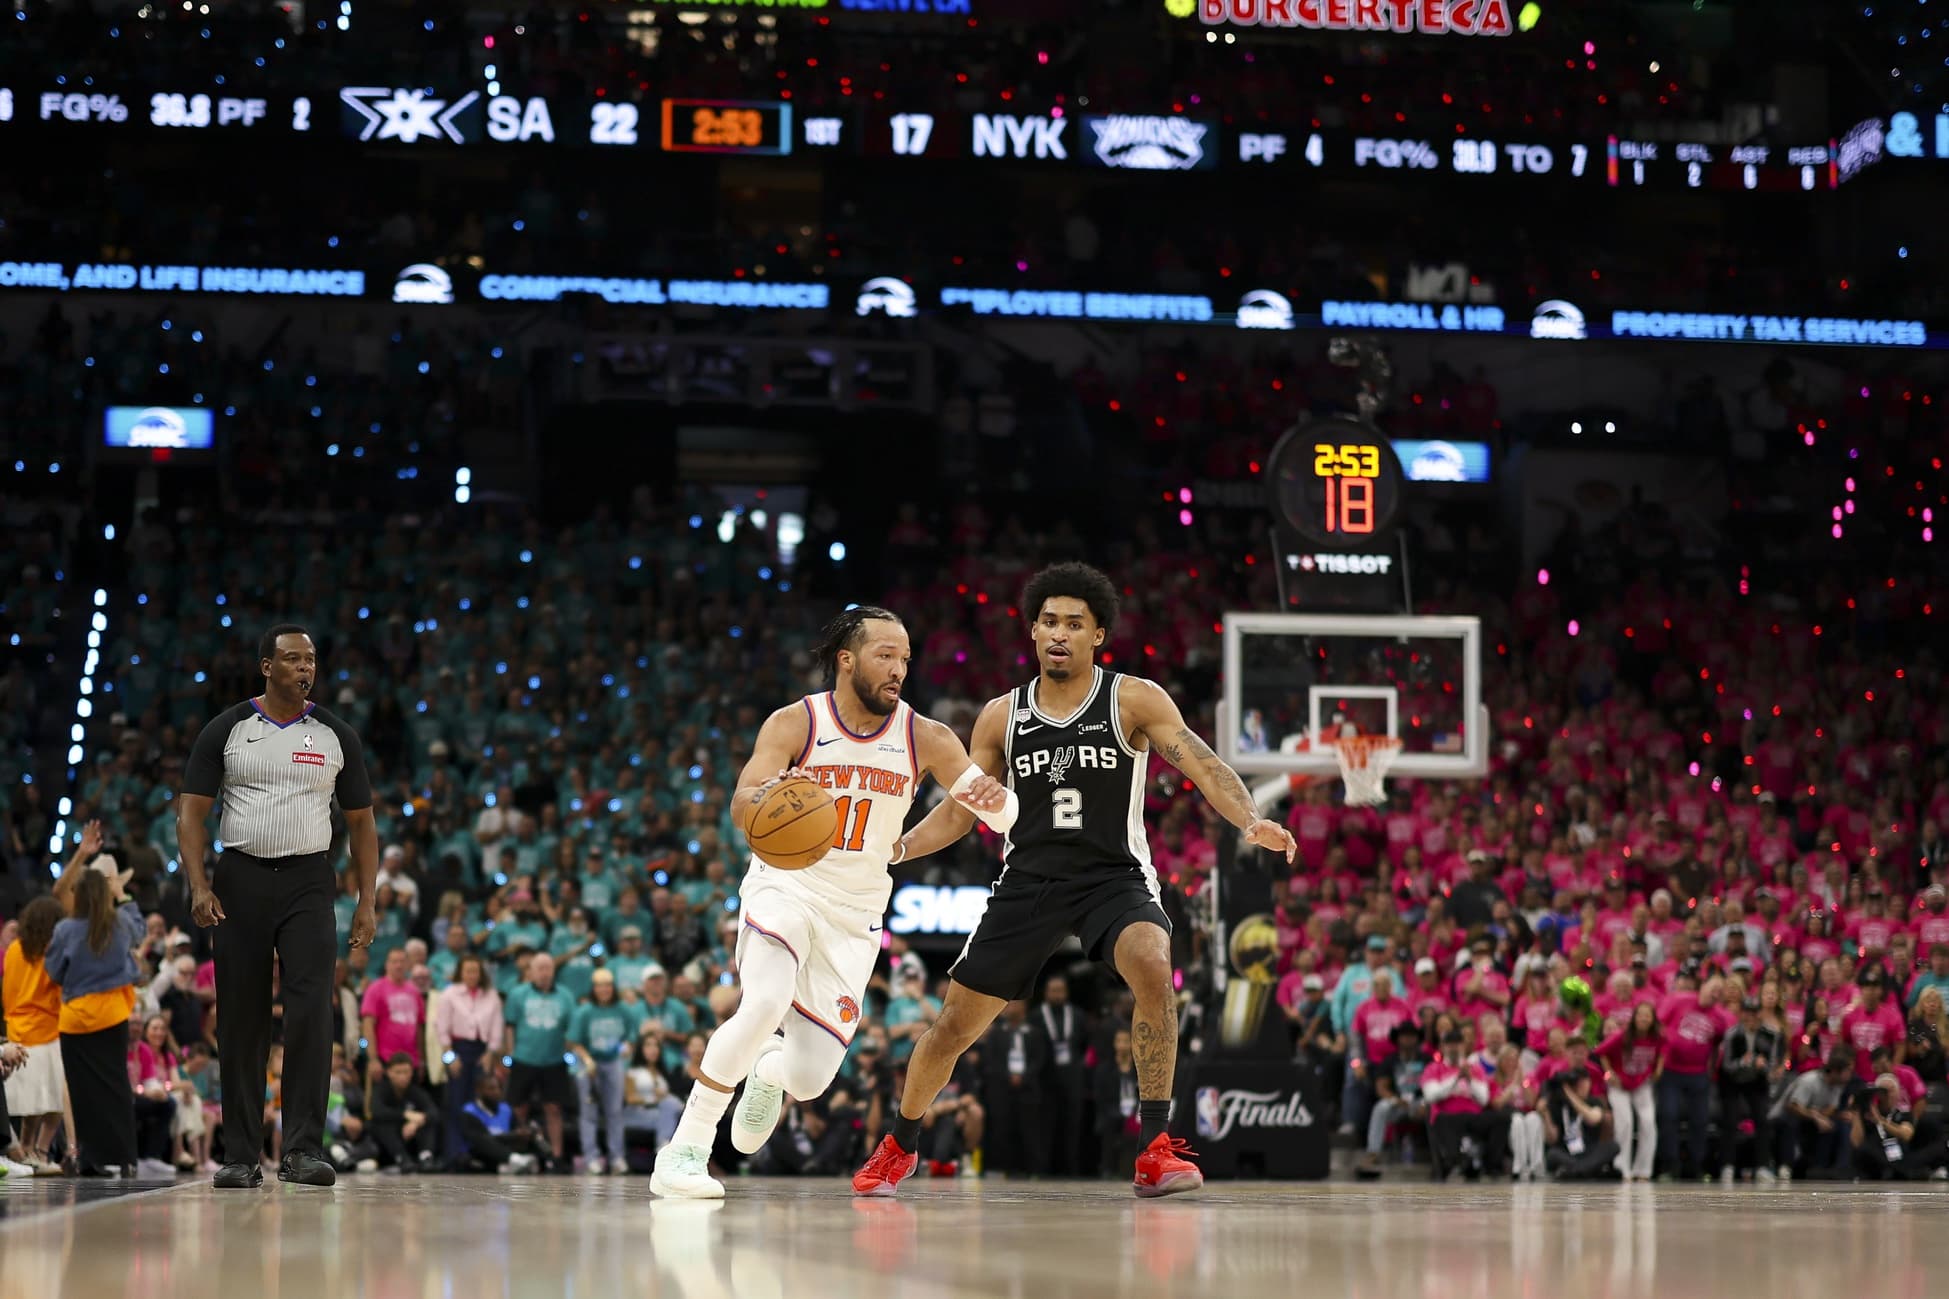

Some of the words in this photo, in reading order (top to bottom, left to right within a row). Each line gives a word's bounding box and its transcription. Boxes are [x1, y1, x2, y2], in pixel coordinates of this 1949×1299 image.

[40, 93, 128, 122] FG%
[218, 98, 266, 126] PF
[293, 97, 310, 130] 2
[487, 97, 554, 142] SA
[590, 102, 638, 144] 22
[693, 110, 761, 146] 2:53
[890, 113, 933, 155] 17
[973, 114, 1067, 159] NYK
[1884, 112, 1924, 157] &
[1240, 134, 1285, 162] PF
[1355, 138, 1438, 168] FG%
[1505, 144, 1553, 173] TO
[73, 264, 137, 289] AND
[139, 265, 200, 291] LIFE
[201, 267, 365, 295] INSURANCE
[669, 279, 829, 308] INSURANCE
[1085, 292, 1214, 322] BENEFITS
[1322, 301, 1435, 329] PAYROLL
[1437, 305, 1461, 330] &
[1462, 306, 1505, 331] HR
[1612, 311, 1750, 339] PROPERTY
[1750, 316, 1801, 341] TAX
[1802, 318, 1927, 345] SERVICES
[1314, 444, 1380, 478] 2:53
[1324, 477, 1375, 533] 18
[1313, 554, 1391, 574] TISSOT
[293, 754, 324, 764] Emirates
[855, 766, 910, 798] YORK
[830, 794, 873, 852] 11
[1052, 787, 1083, 830] 2
[1209, 1089, 1313, 1141] Finals
